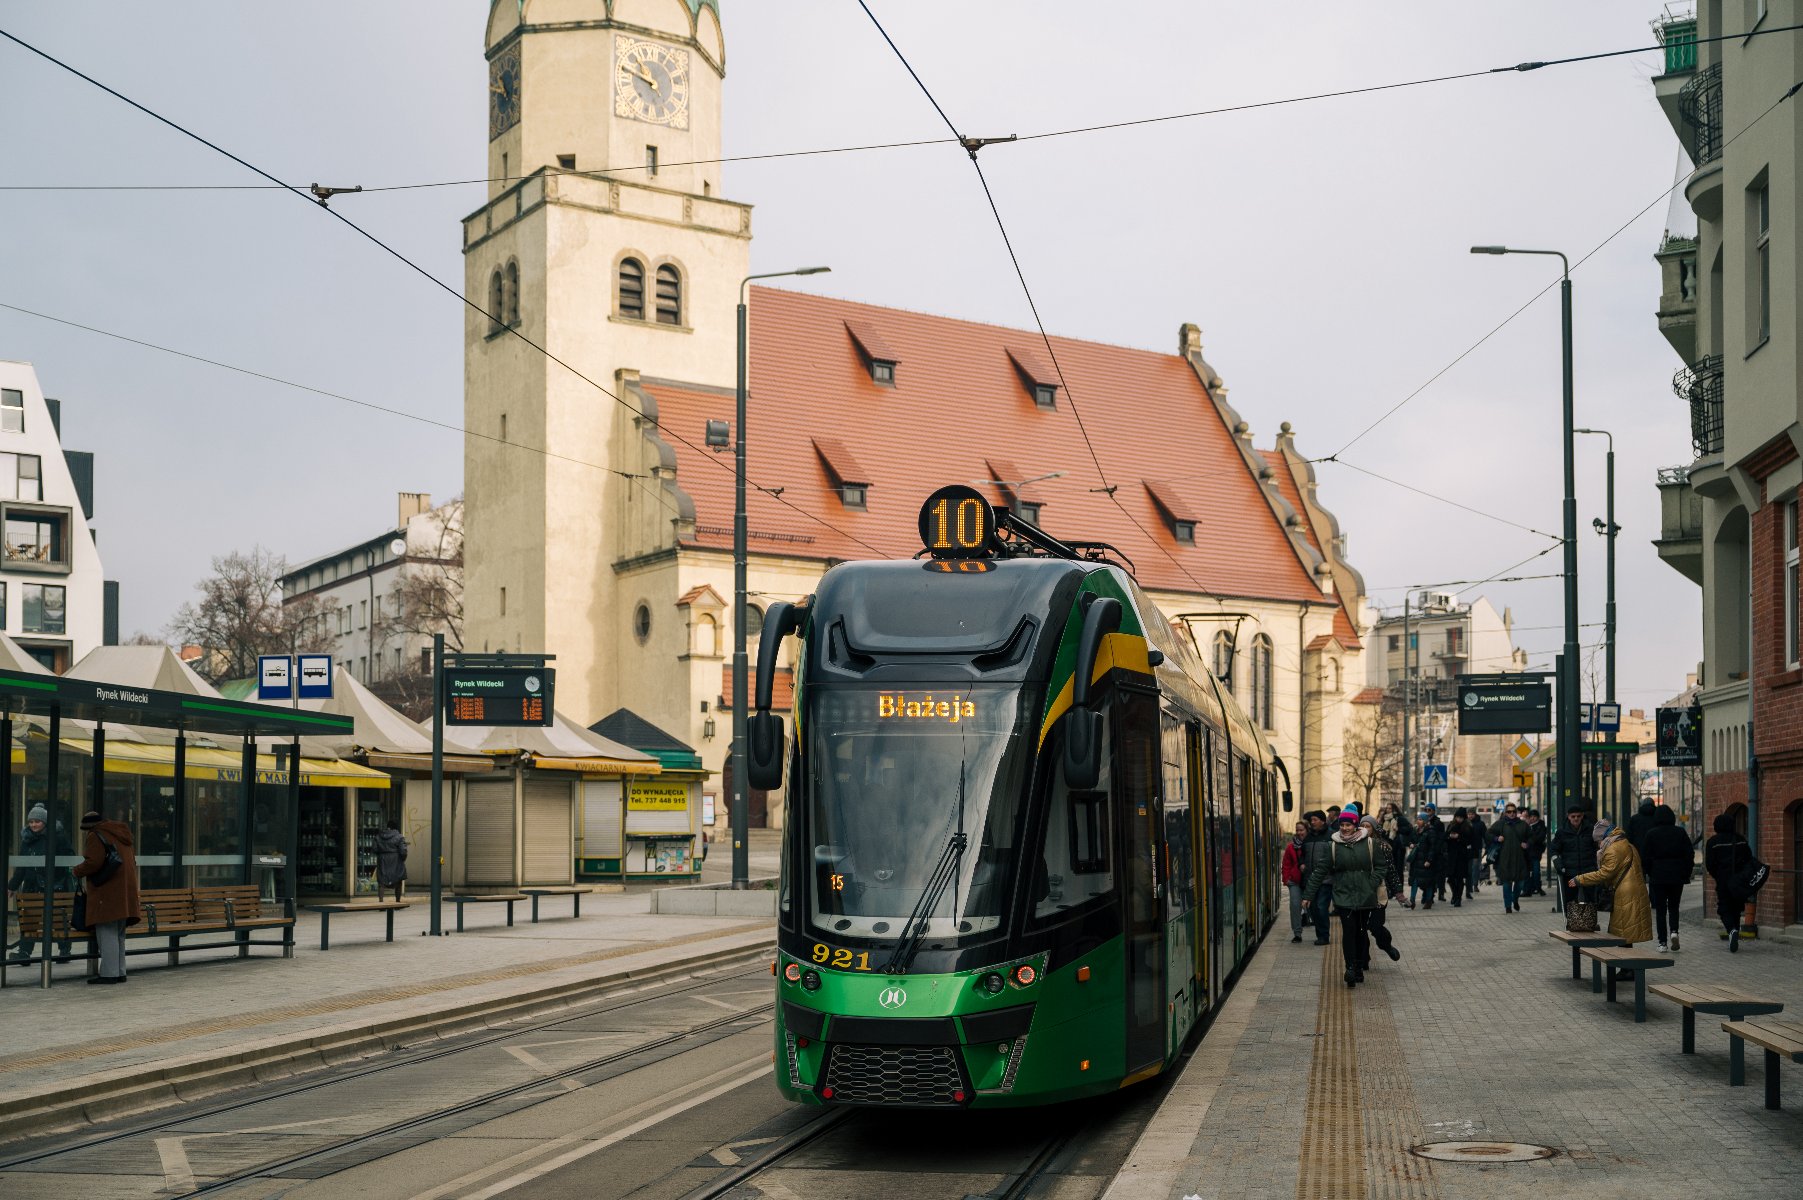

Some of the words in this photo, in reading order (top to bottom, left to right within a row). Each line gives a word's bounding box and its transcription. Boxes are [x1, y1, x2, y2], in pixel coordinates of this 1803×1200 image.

[932, 498, 984, 548] 10
[454, 680, 475, 688] Rynek
[96, 687, 118, 701] Rynek
[119, 690, 149, 704] Wildecki
[1480, 695, 1499, 703] Rynek
[879, 695, 976, 723] Błażeja
[575, 762, 627, 774] KWIACIARNIA
[217, 768, 262, 783] KWIY
[265, 772, 310, 786] MARLI
[643, 789, 685, 797] WYNAJĘCIA
[831, 874, 844, 891] 15
[812, 943, 872, 971] 921
